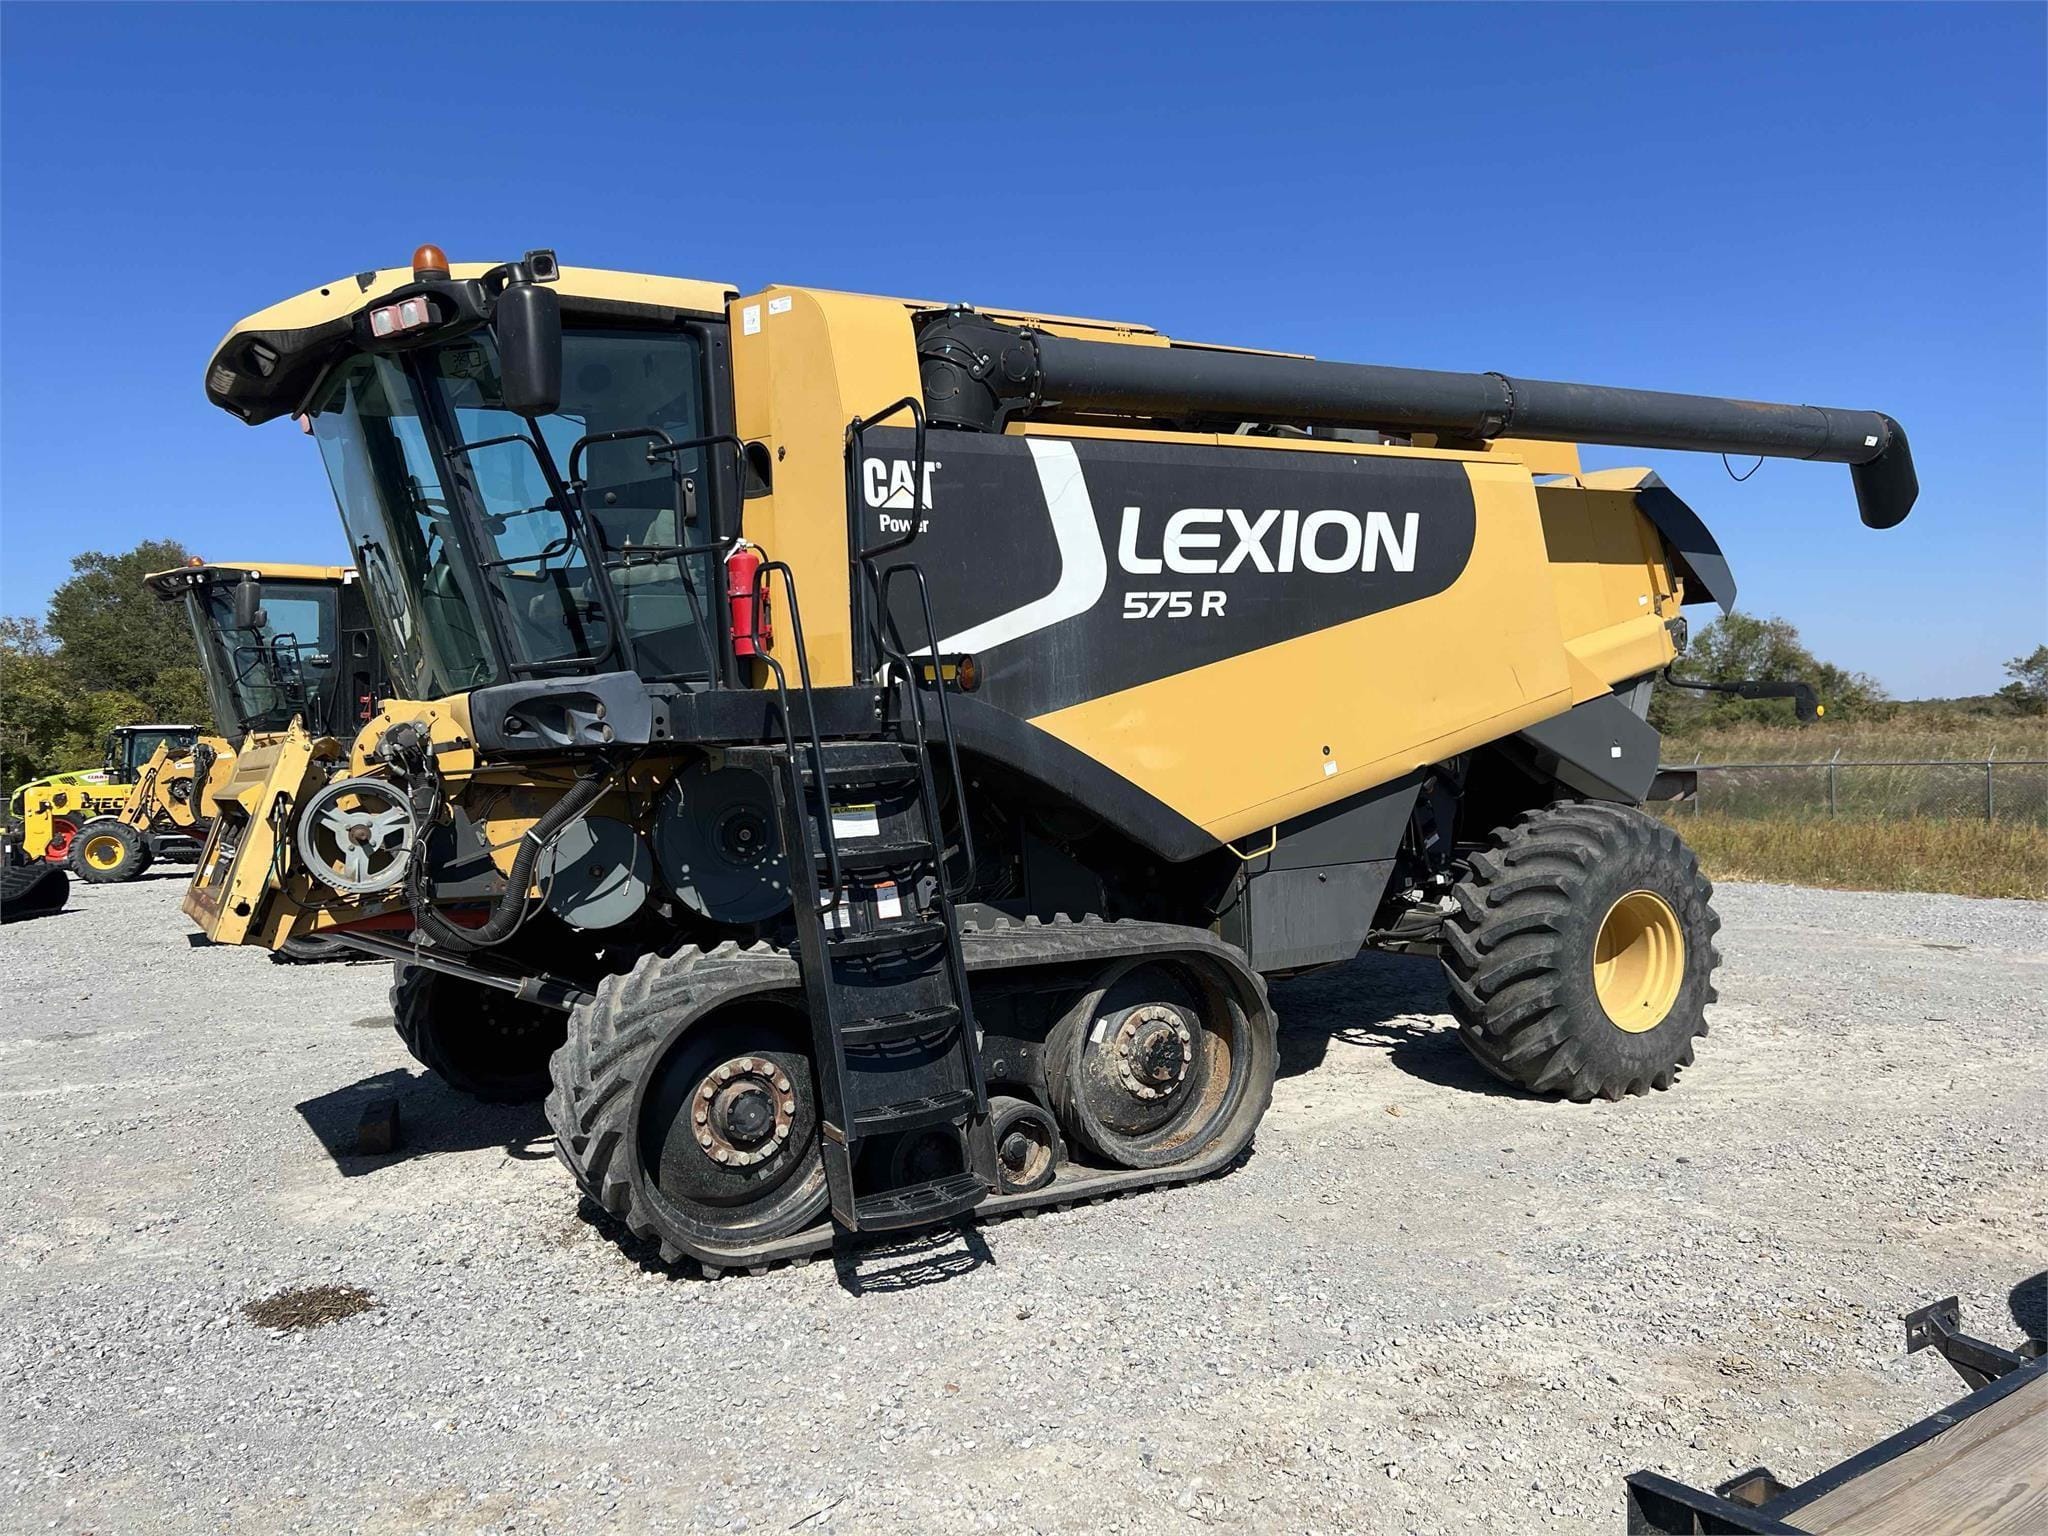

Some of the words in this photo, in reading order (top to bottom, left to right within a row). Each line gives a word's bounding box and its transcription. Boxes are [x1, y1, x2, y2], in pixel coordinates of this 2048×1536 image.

[863, 457, 935, 510] CAT
[1118, 506, 1420, 574] LEXION
[1122, 591, 1193, 619] 575
[1201, 590, 1227, 617] R
